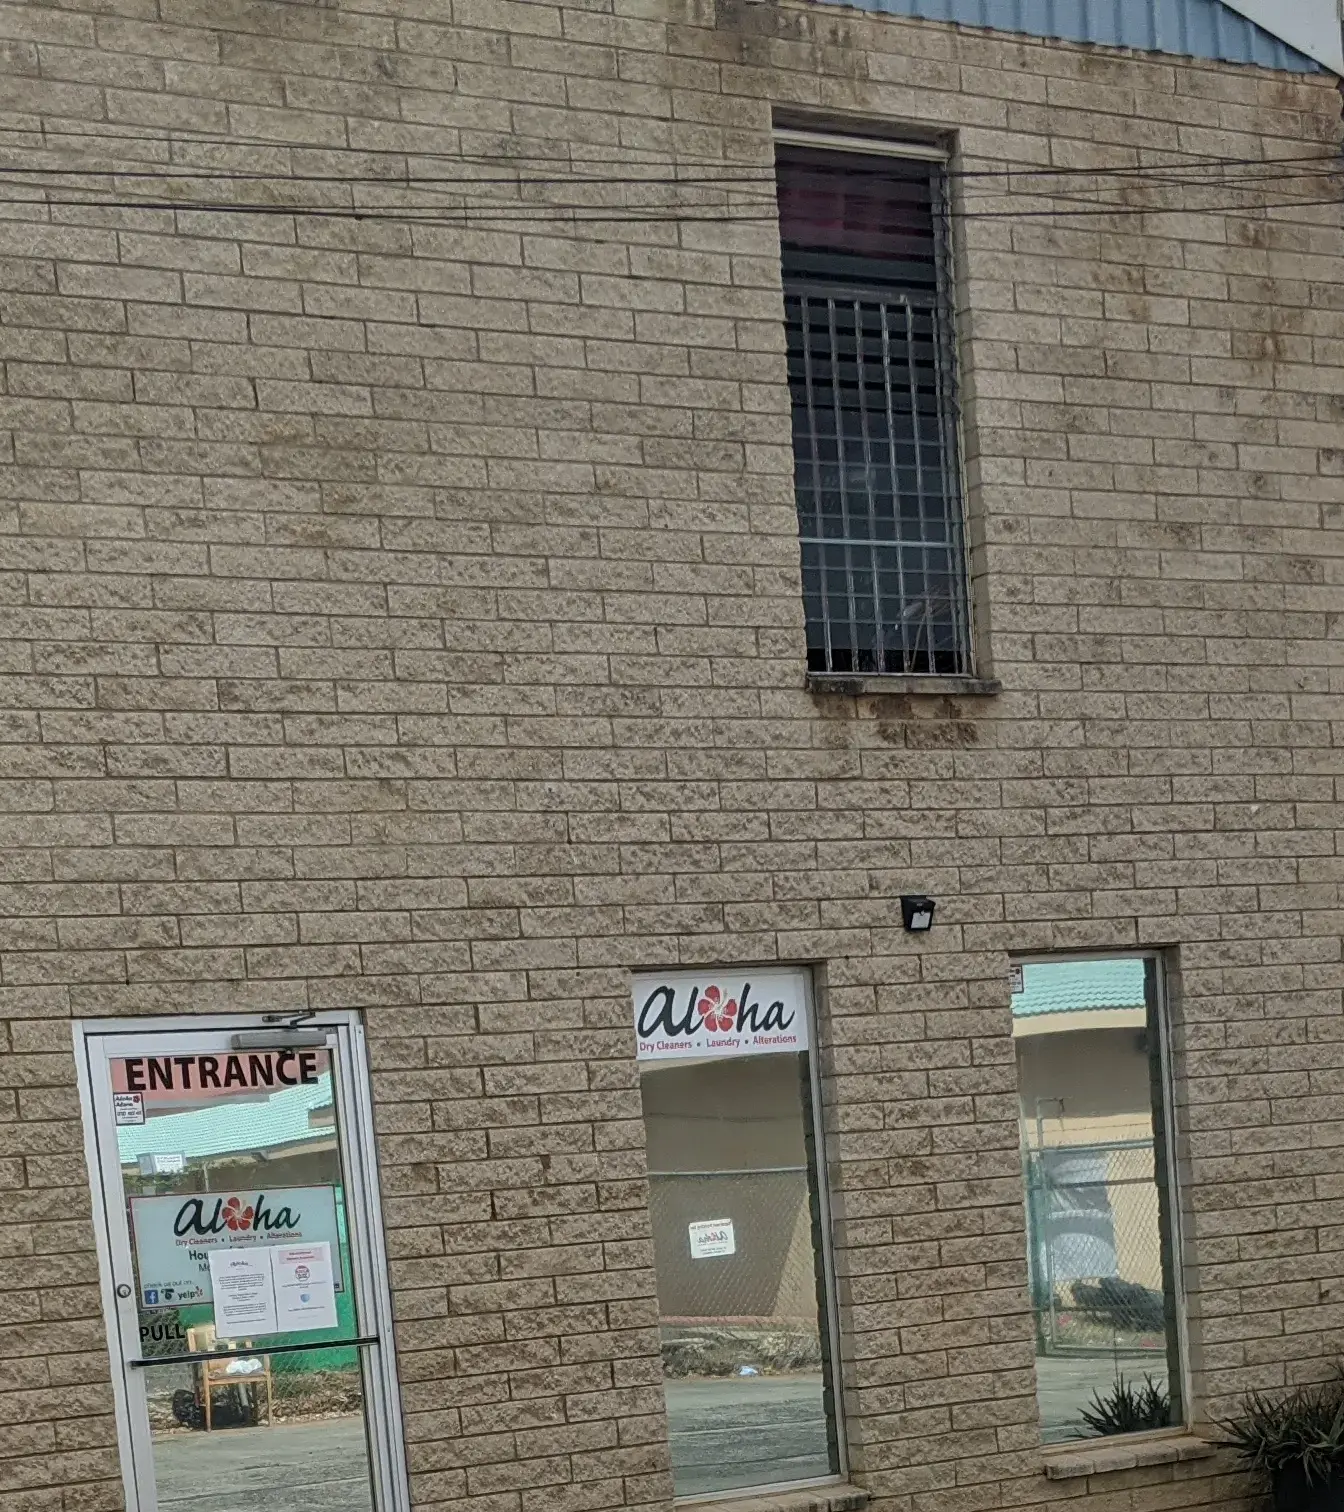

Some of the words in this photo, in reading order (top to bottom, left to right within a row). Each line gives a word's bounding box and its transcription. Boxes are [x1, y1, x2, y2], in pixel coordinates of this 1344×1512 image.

[639, 1041, 655, 1053] Dry
[656, 1040, 693, 1050] Cleaners
[706, 1037, 740, 1049] Laundry
[752, 1035, 797, 1045] Alterations
[124, 1052, 319, 1091] ENTRANCE
[189, 1250, 209, 1260] Hou
[139, 1323, 186, 1343] PULL
